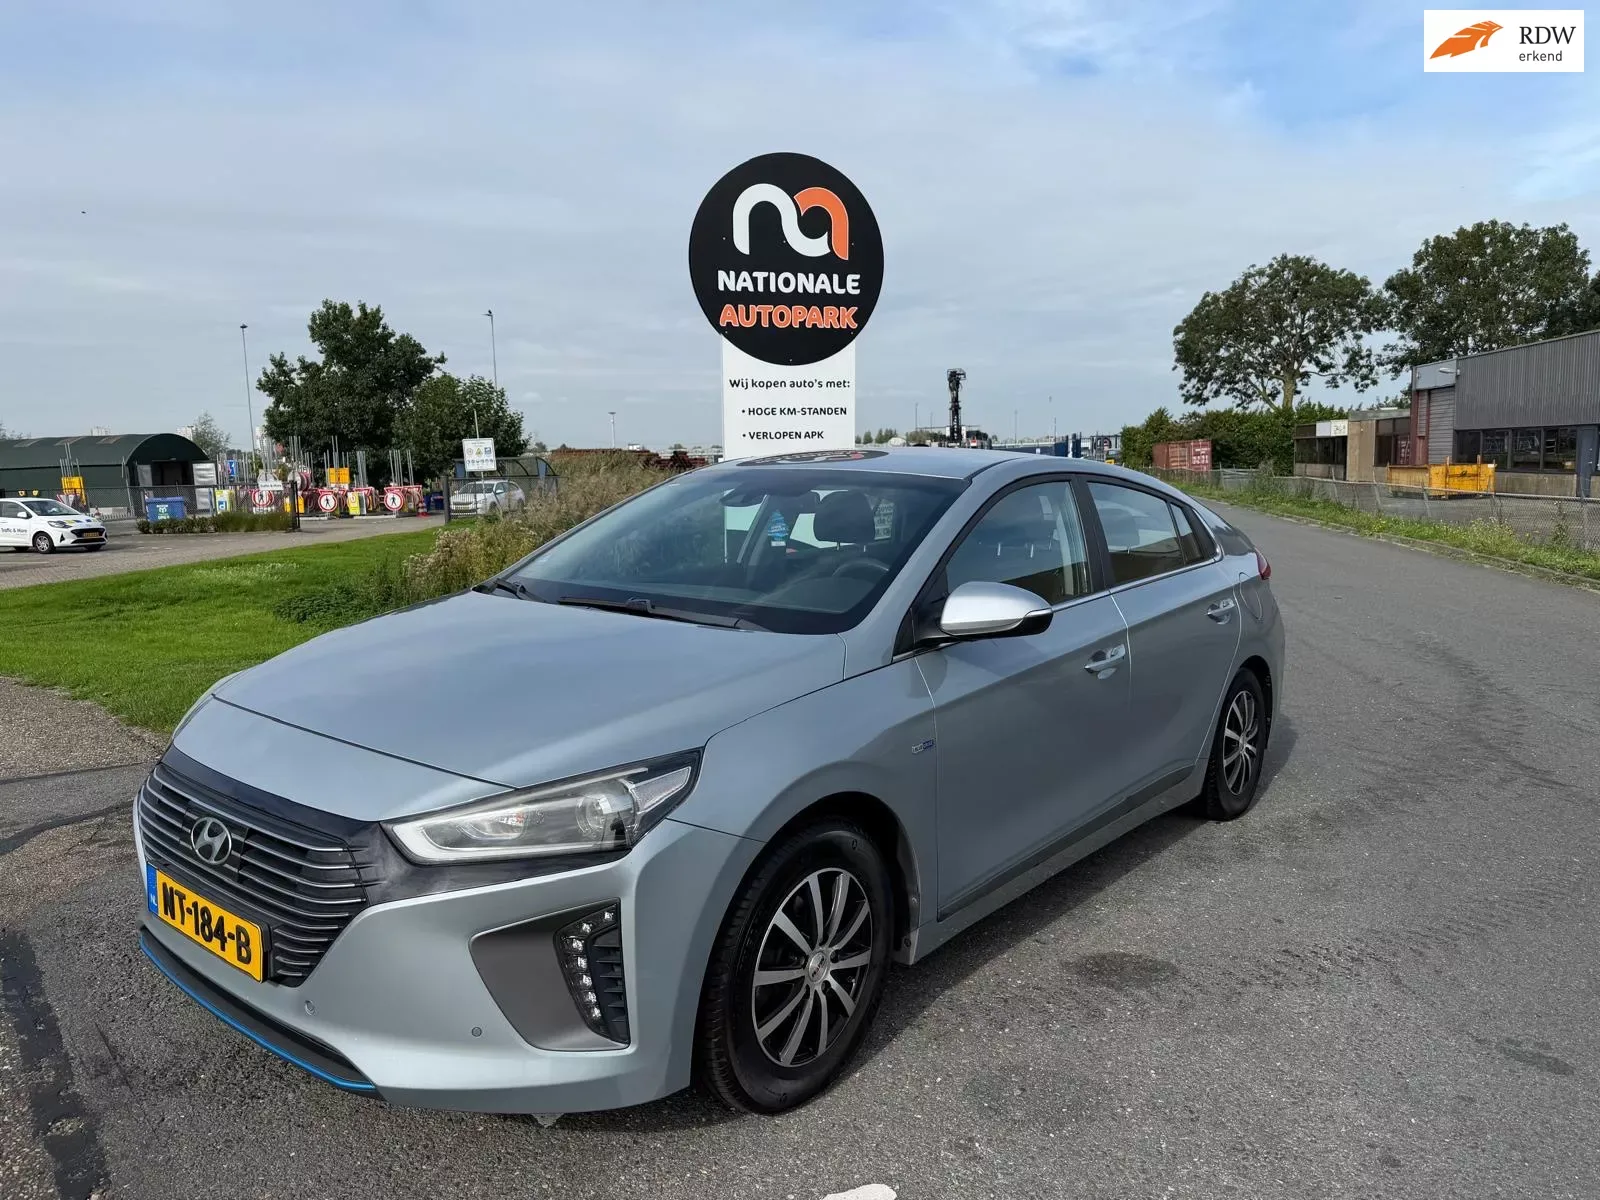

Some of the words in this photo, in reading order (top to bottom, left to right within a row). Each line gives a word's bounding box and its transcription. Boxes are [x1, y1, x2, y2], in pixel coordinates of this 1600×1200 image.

[717, 270, 861, 295] NATIONALE
[719, 304, 858, 329] AUTOPARK
[729, 378, 748, 390] Wij
[751, 379, 786, 390] kopen
[789, 379, 823, 388] auto's
[826, 380, 850, 388] met:
[748, 407, 777, 416] HOGE
[779, 407, 847, 416] KM-STANDEN
[749, 431, 801, 440] VERLOPEN
[804, 431, 824, 439] APK
[162, 882, 251, 965] NT-184-B
